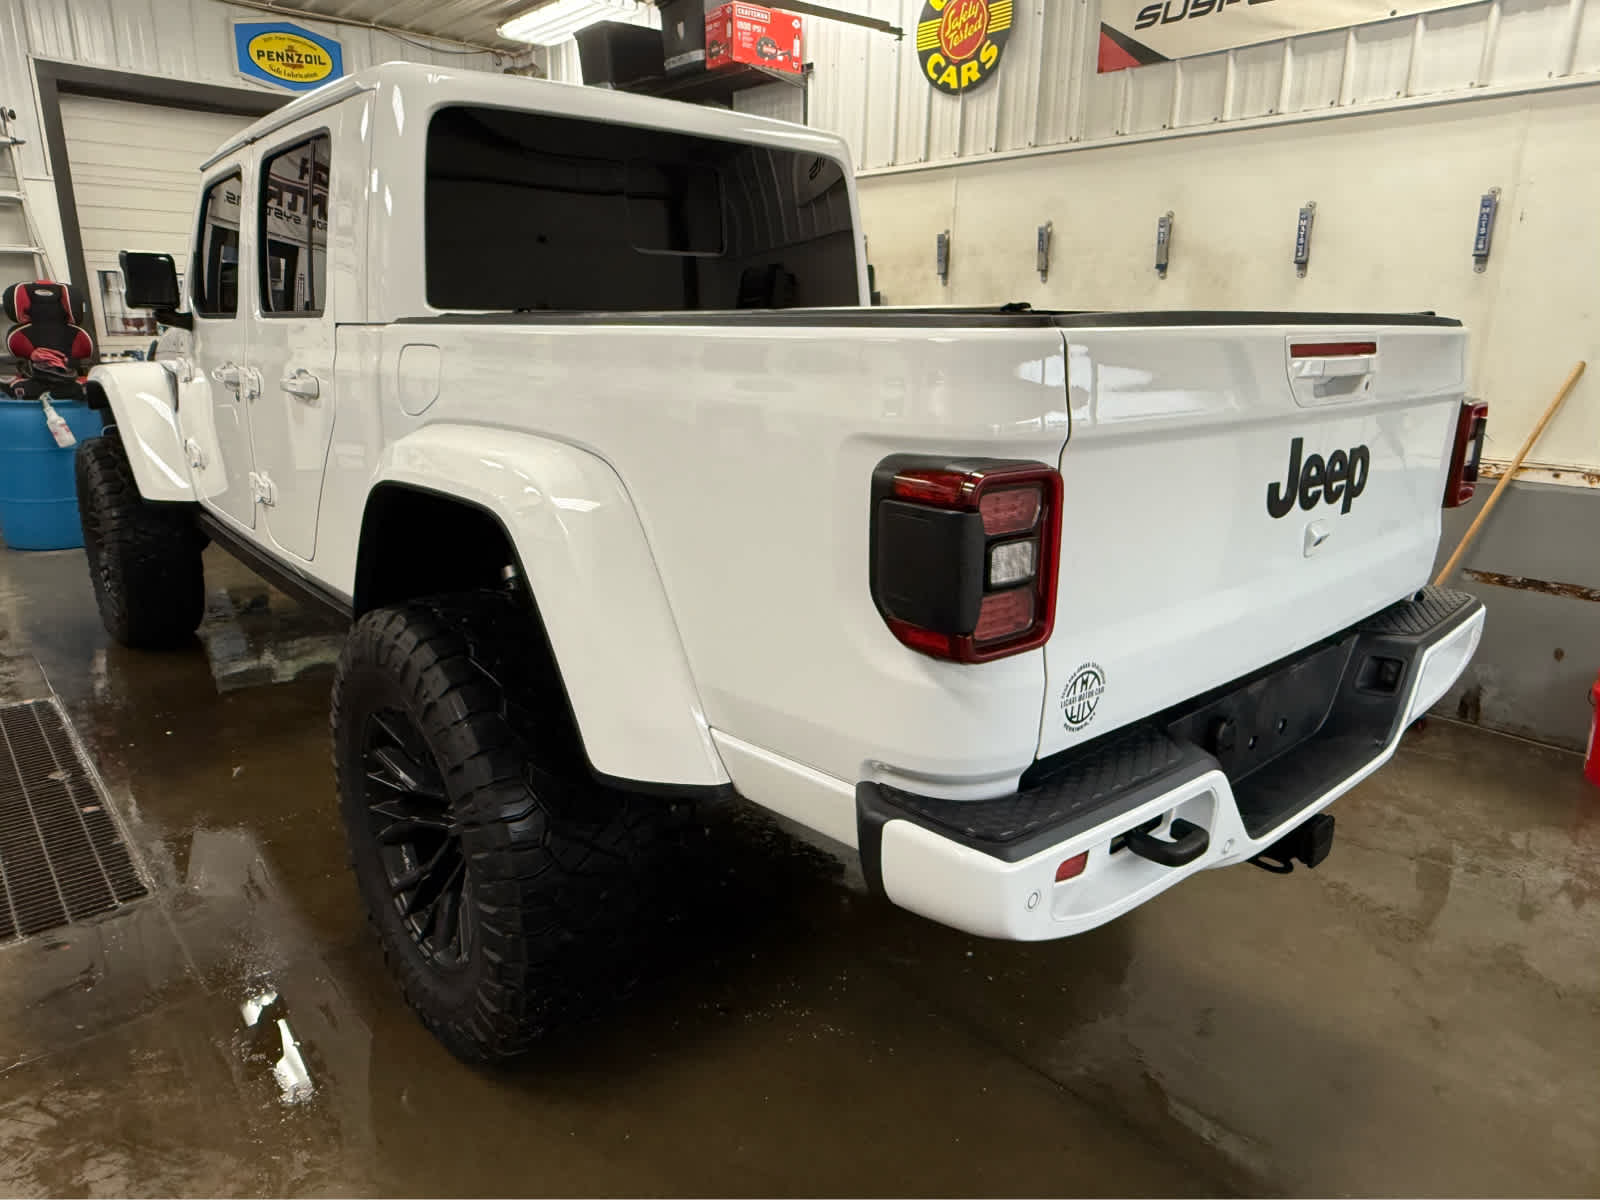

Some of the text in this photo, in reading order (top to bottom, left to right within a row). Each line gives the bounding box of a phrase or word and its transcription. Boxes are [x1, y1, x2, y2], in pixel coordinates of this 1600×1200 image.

[945, 1, 979, 37] Safety
[948, 13, 983, 50] Tested
[256, 49, 327, 66] PENNZOIL
[927, 40, 998, 89] CARS
[1266, 437, 1370, 519] Jeep
